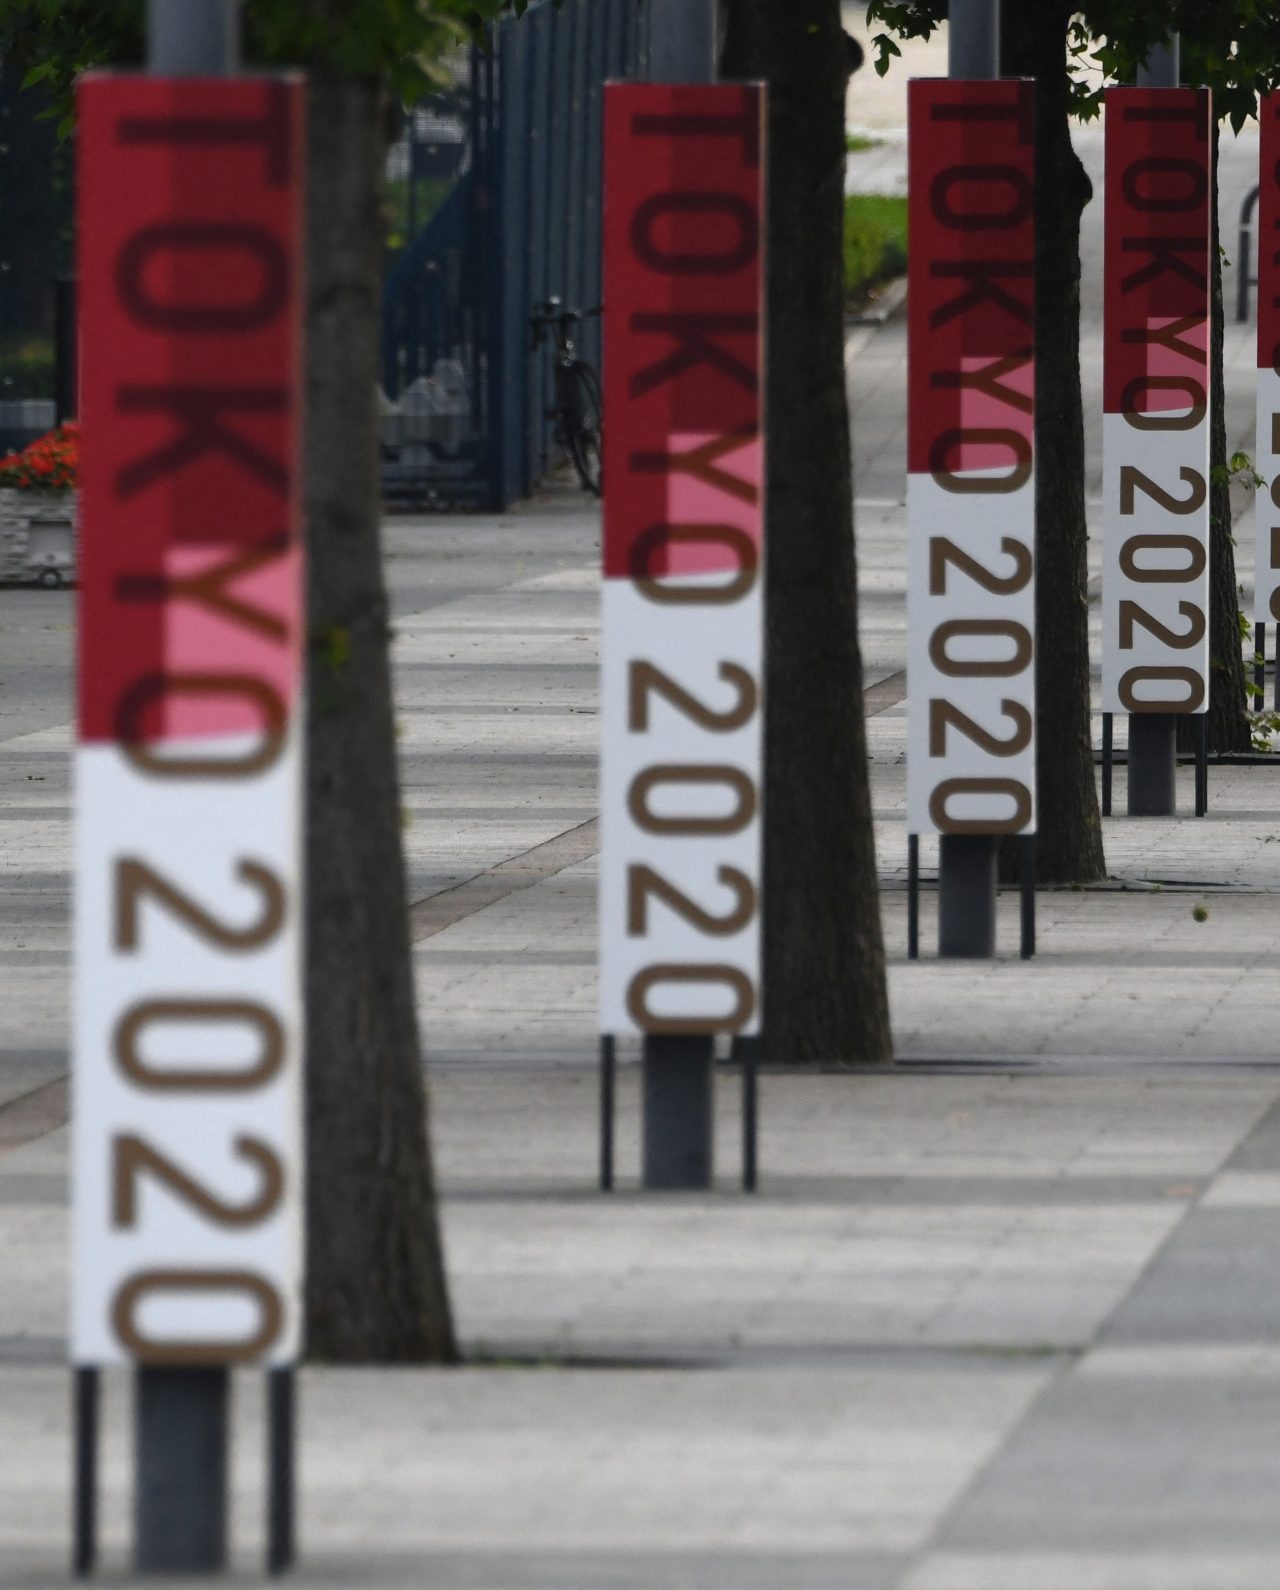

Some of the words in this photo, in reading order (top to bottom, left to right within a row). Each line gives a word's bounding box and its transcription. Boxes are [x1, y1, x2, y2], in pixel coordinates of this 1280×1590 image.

[114, 77, 291, 780] TOKYO
[630, 82, 759, 606] TOKYO
[930, 80, 1033, 494] TOKYO
[1121, 86, 1208, 431] TOKYO
[929, 537, 1032, 834] 2020
[1118, 466, 1207, 713] 2020
[627, 661, 757, 1034] 2020
[111, 855, 287, 1363] 2020
